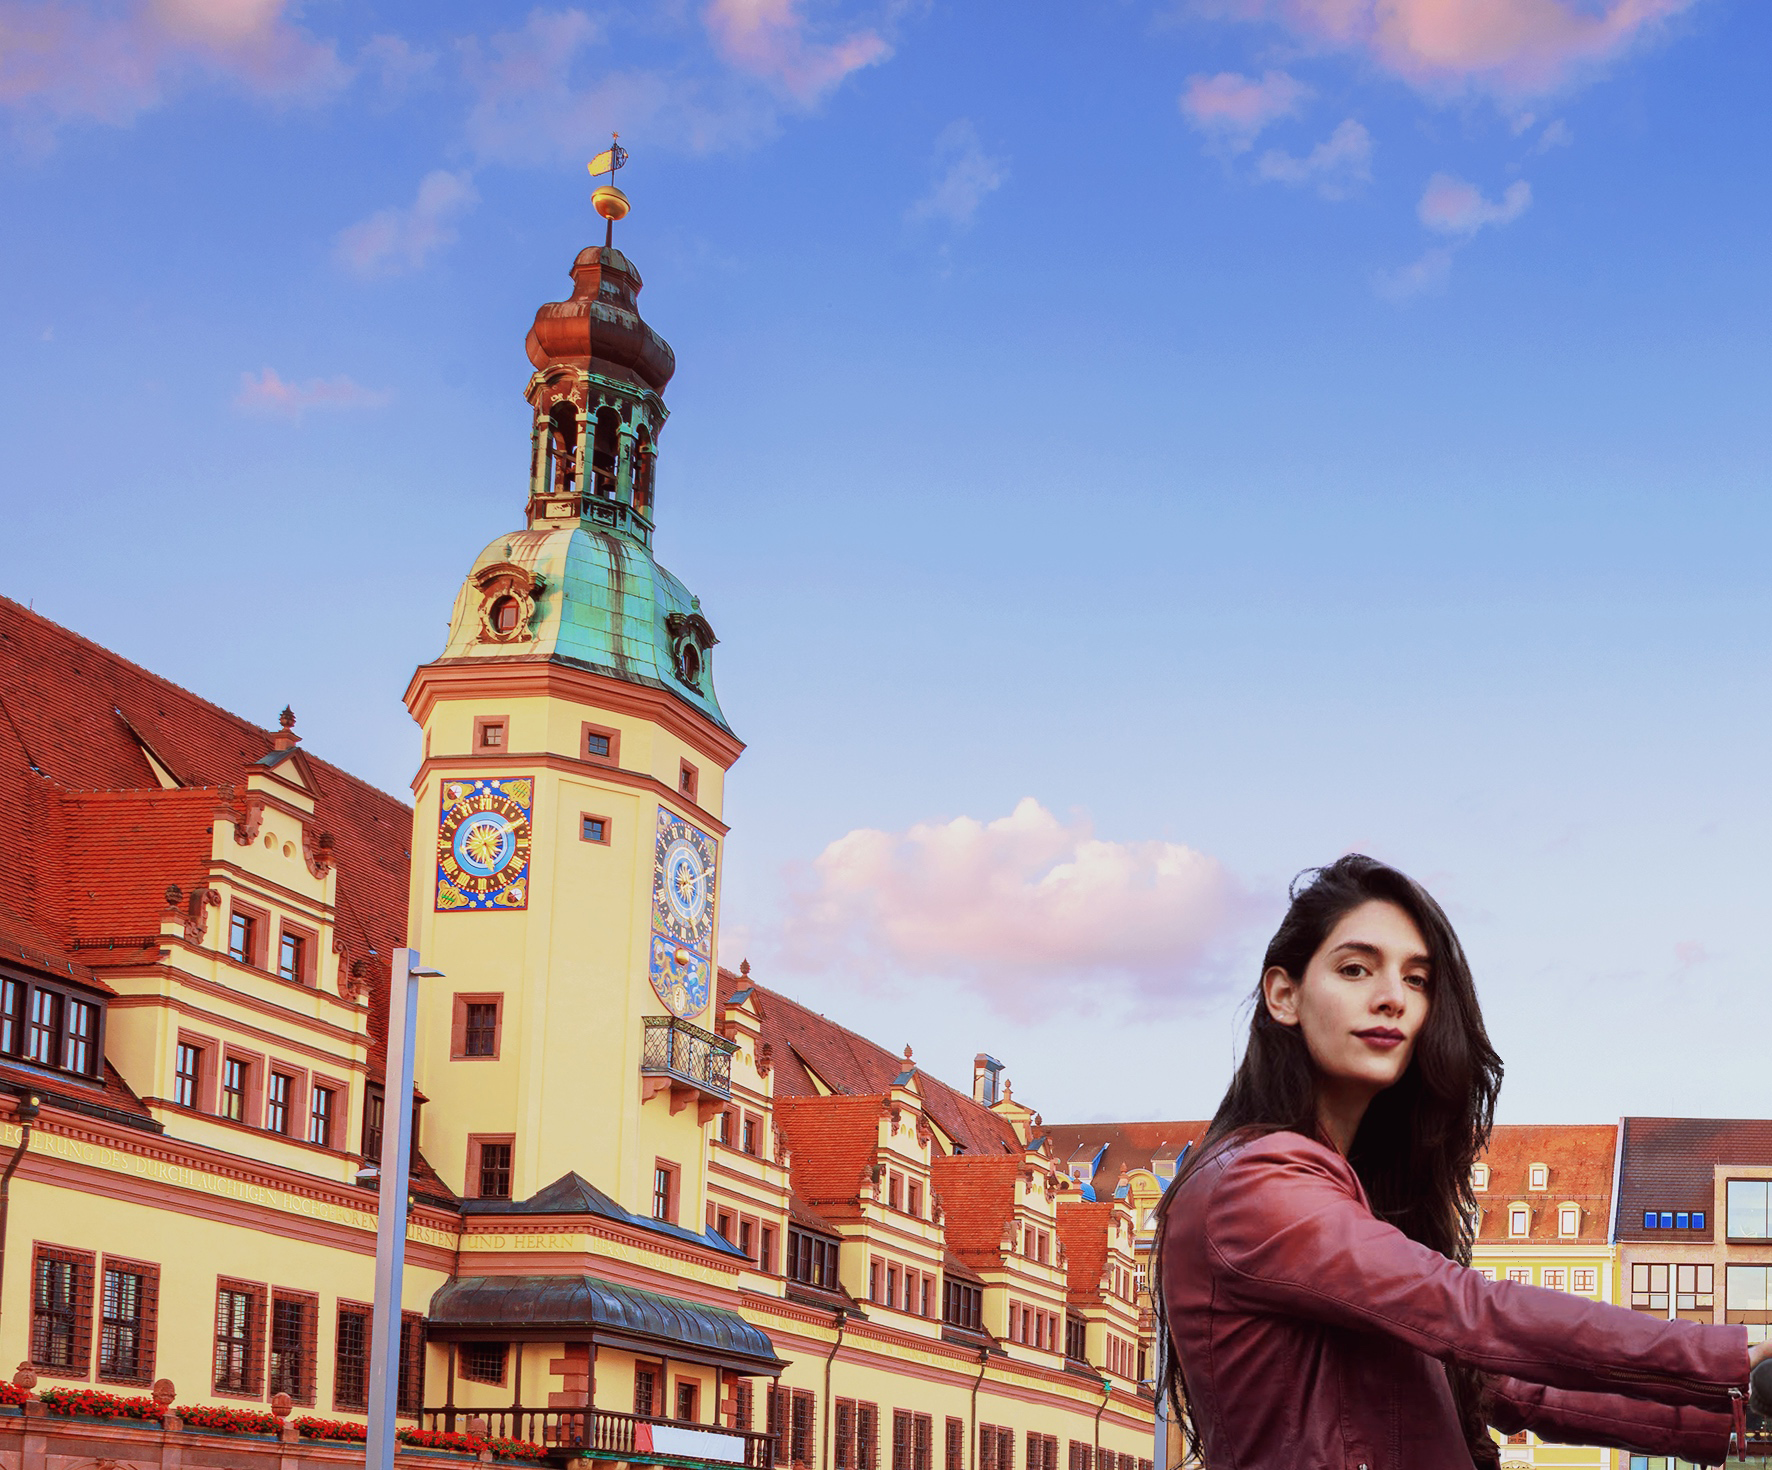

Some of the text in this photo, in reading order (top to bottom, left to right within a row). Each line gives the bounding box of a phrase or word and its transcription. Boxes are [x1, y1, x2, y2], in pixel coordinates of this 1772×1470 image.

[100, 1149, 129, 1169] DES
[467, 1235, 574, 1249] UND HERRN
